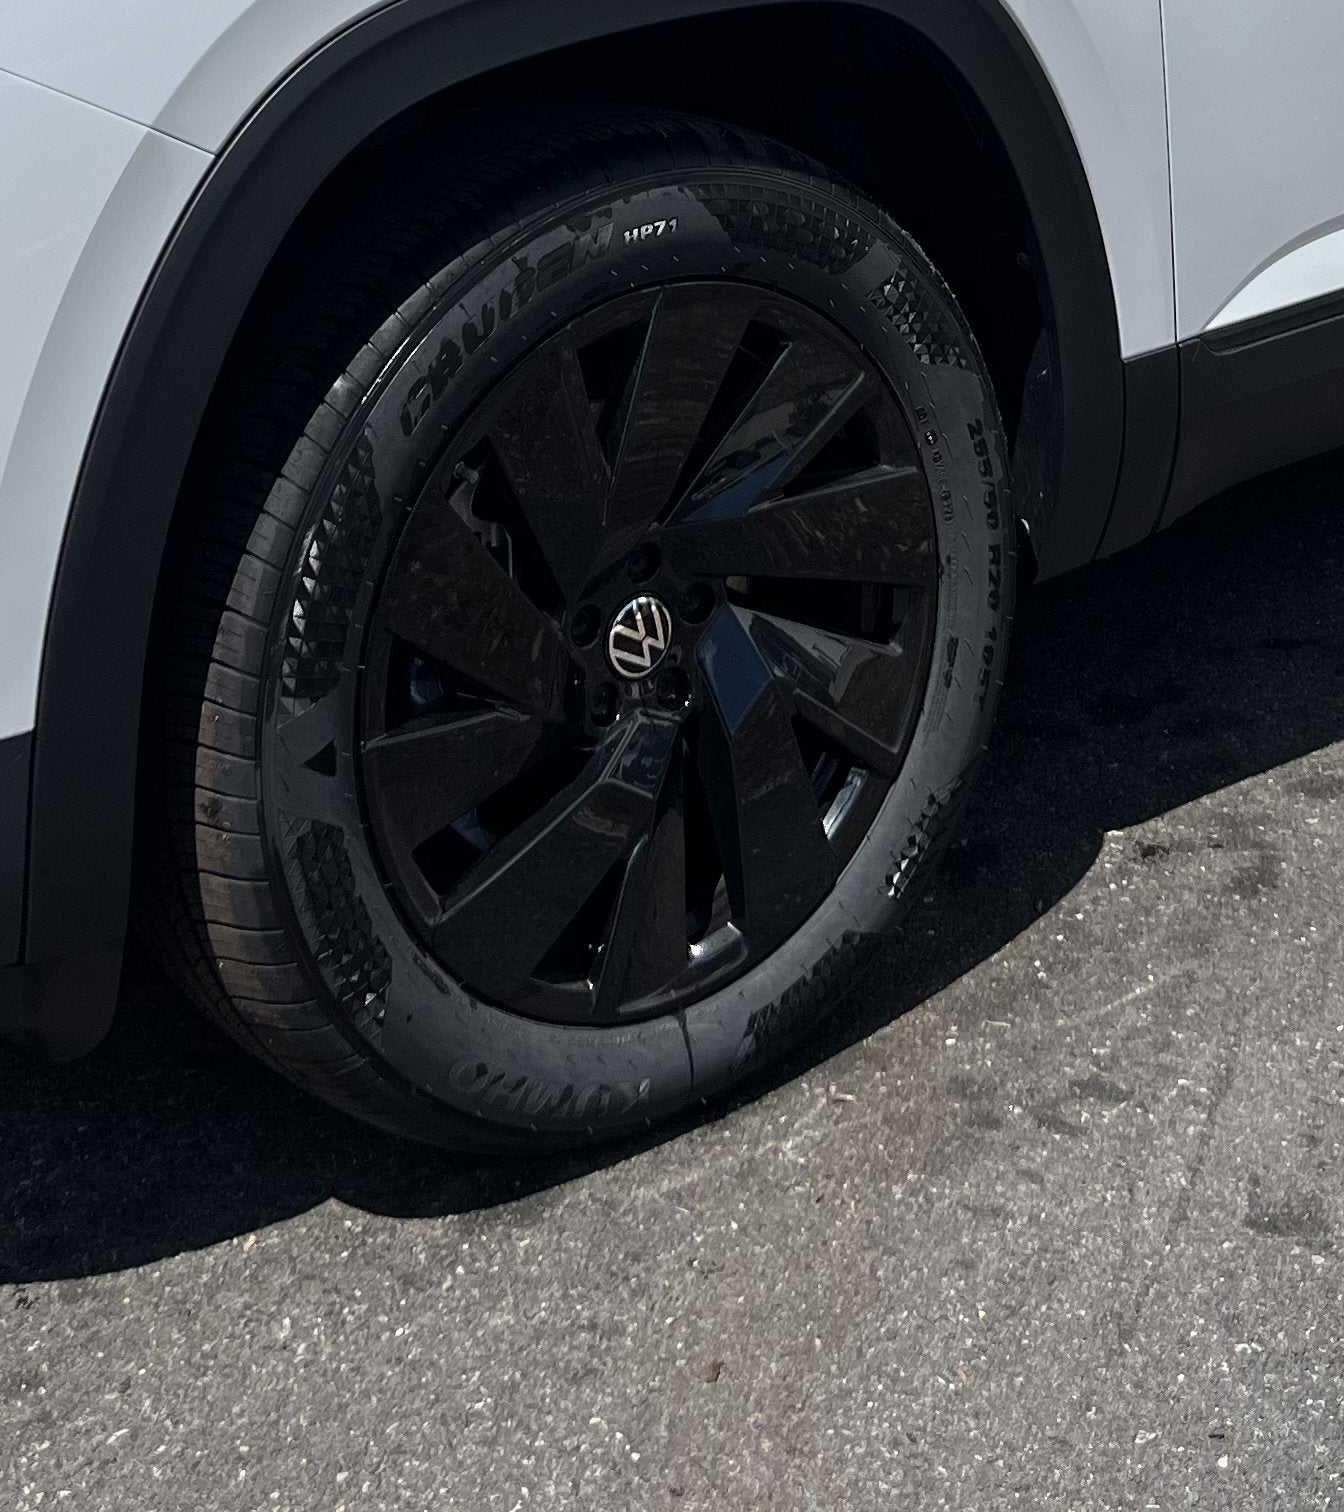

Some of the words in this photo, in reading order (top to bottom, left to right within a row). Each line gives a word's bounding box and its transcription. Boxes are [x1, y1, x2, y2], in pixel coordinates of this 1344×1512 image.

[623, 218, 677, 245] HP71
[987, 543, 1002, 611] R20
[447, 1059, 651, 1120] KUMHO
